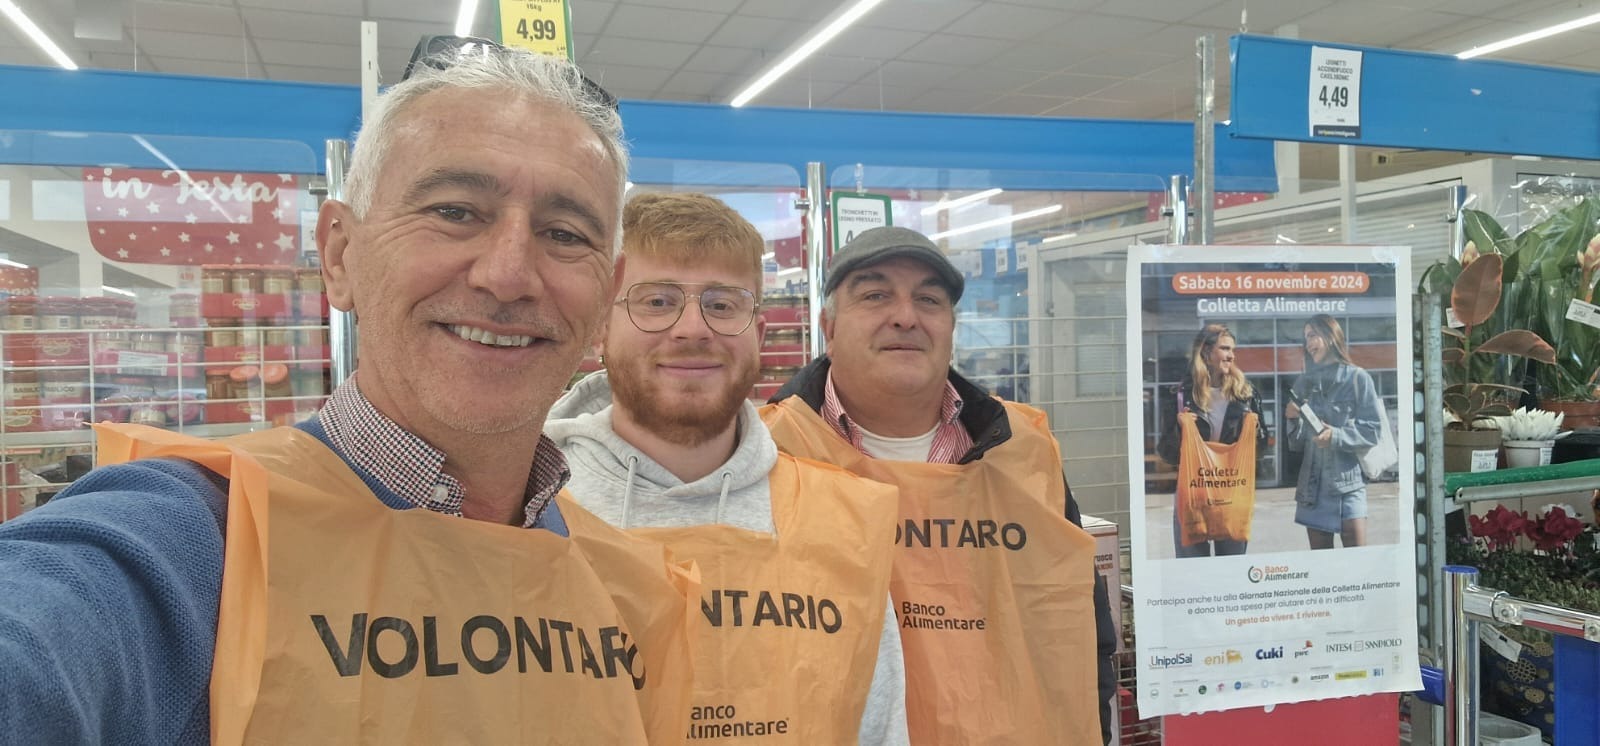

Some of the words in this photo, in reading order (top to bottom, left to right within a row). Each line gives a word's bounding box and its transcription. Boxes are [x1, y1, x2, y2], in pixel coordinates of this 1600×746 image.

[516, 18, 556, 41] 4,99
[1318, 85, 1349, 109] 4,49
[102, 167, 152, 199] in
[1179, 274, 1231, 290] Sabato
[1235, 275, 1253, 290] 16
[1256, 273, 1327, 290] novembre
[1330, 275, 1364, 289] 2024
[1197, 297, 1261, 313] Colletta
[1263, 297, 1346, 313] Alimentare
[1189, 477, 1247, 489] Alimentare
[894, 518, 1027, 552] NTARO
[1264, 565, 1289, 574] Banco
[1264, 571, 1309, 581] Alimentare
[1146, 598, 1186, 607] Partecipa
[1186, 595, 1212, 604] anche
[1223, 593, 1238, 602] alla
[1239, 591, 1273, 601] Giornata
[1273, 588, 1311, 598] Nazionale
[1311, 586, 1331, 595] della
[1331, 584, 1361, 593] Colletta
[1361, 581, 1401, 591] Alimentare
[902, 601, 946, 616] Banco
[1194, 606, 1216, 615] dona
[1216, 605, 1225, 613] la
[1225, 605, 1239, 613] tua
[1240, 603, 1263, 612] spesa
[1264, 601, 1277, 610] per
[1278, 599, 1305, 608] aiutare
[1305, 597, 1317, 605] chi
[1325, 596, 1333, 604] in
[902, 615, 986, 630] Alimentare
[1225, 617, 1236, 626] Un
[1237, 616, 1259, 627] gesto
[1259, 615, 1270, 623] da
[1255, 645, 1284, 661] Cuki
[1325, 642, 1353, 654] INTESA
[1150, 652, 1193, 669] UnipolSai
[1204, 651, 1225, 666] eni
[690, 704, 736, 721] anco
